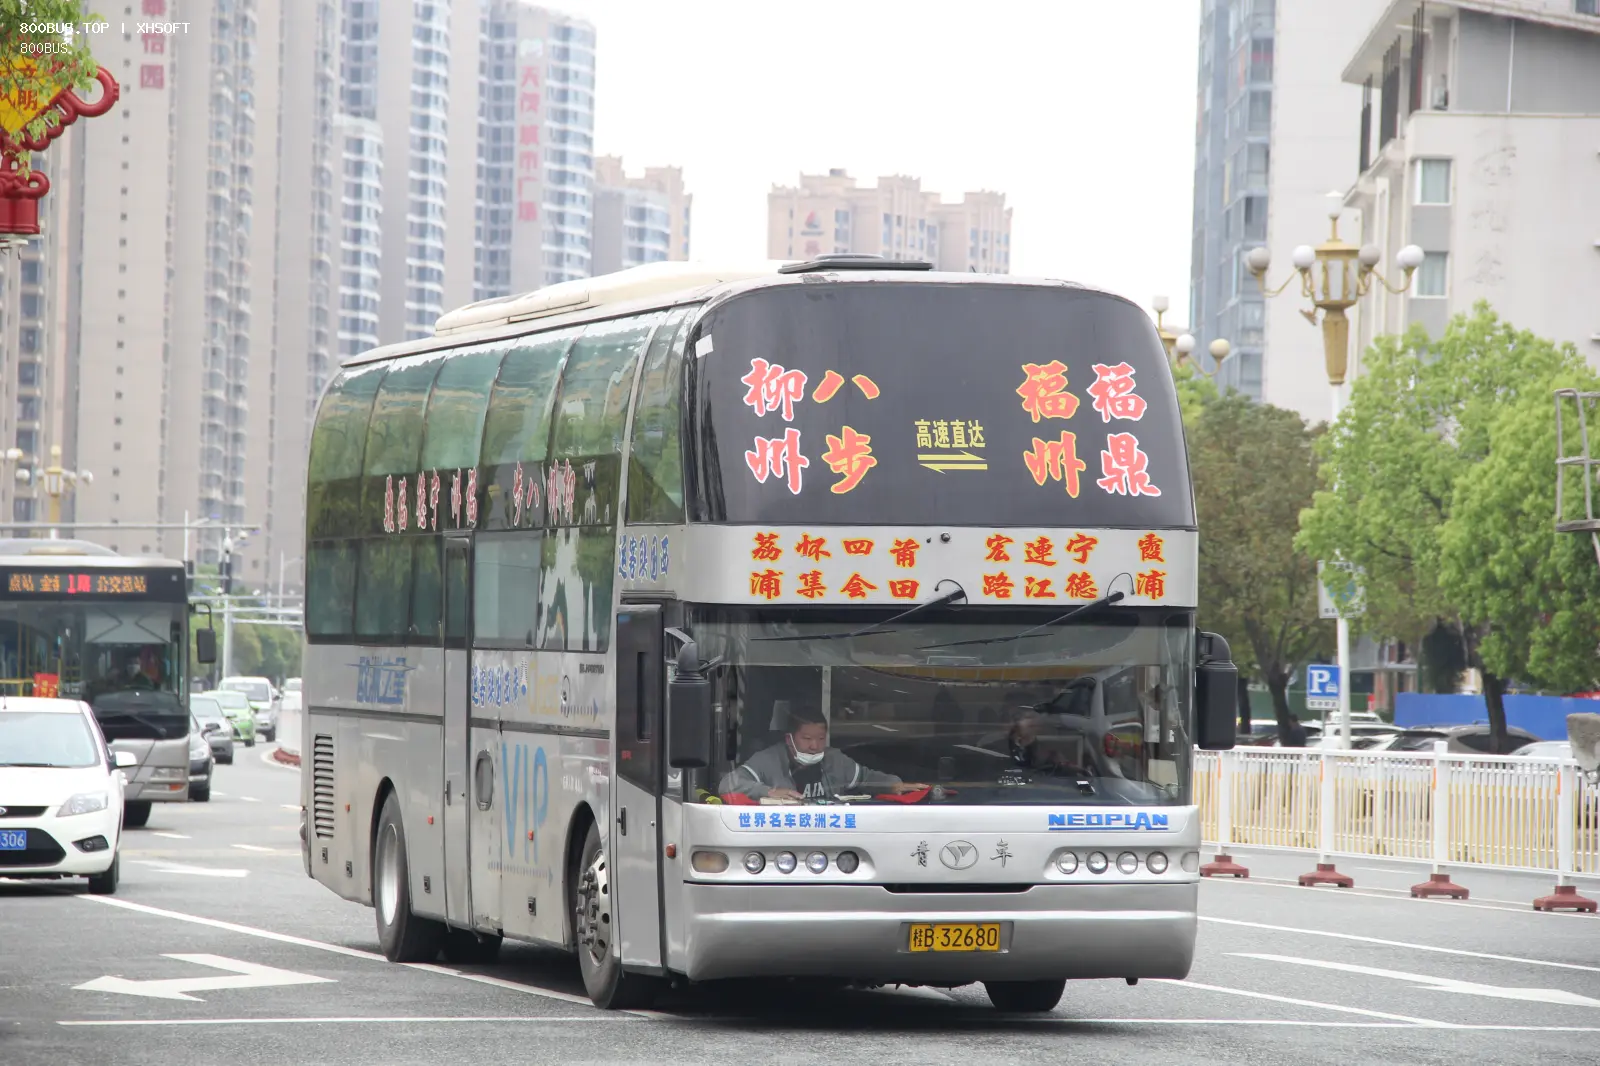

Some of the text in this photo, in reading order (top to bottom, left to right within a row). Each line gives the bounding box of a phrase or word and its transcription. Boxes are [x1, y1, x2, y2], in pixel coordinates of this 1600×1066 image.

[741, 357, 809, 494] 柳州
[812, 369, 880, 494] 八步
[914, 418, 986, 449] 高速直达
[1016, 360, 1086, 498] 福州
[1086, 362, 1161, 496] 福鼎
[749, 532, 784, 600] 荔浦
[795, 532, 832, 599] 怀集
[840, 537, 878, 599] 四会
[888, 538, 922, 599] 莆田
[981, 534, 1015, 599] 宏路
[1064, 532, 1099, 599] 宁德
[1136, 532, 1167, 600] 霞浦
[1310, 670, 1330, 693] P
[501, 742, 549, 864] VIP
[739, 812, 856, 828] 世界名车欧洲之星
[1048, 812, 1168, 830] NEOPLAN
